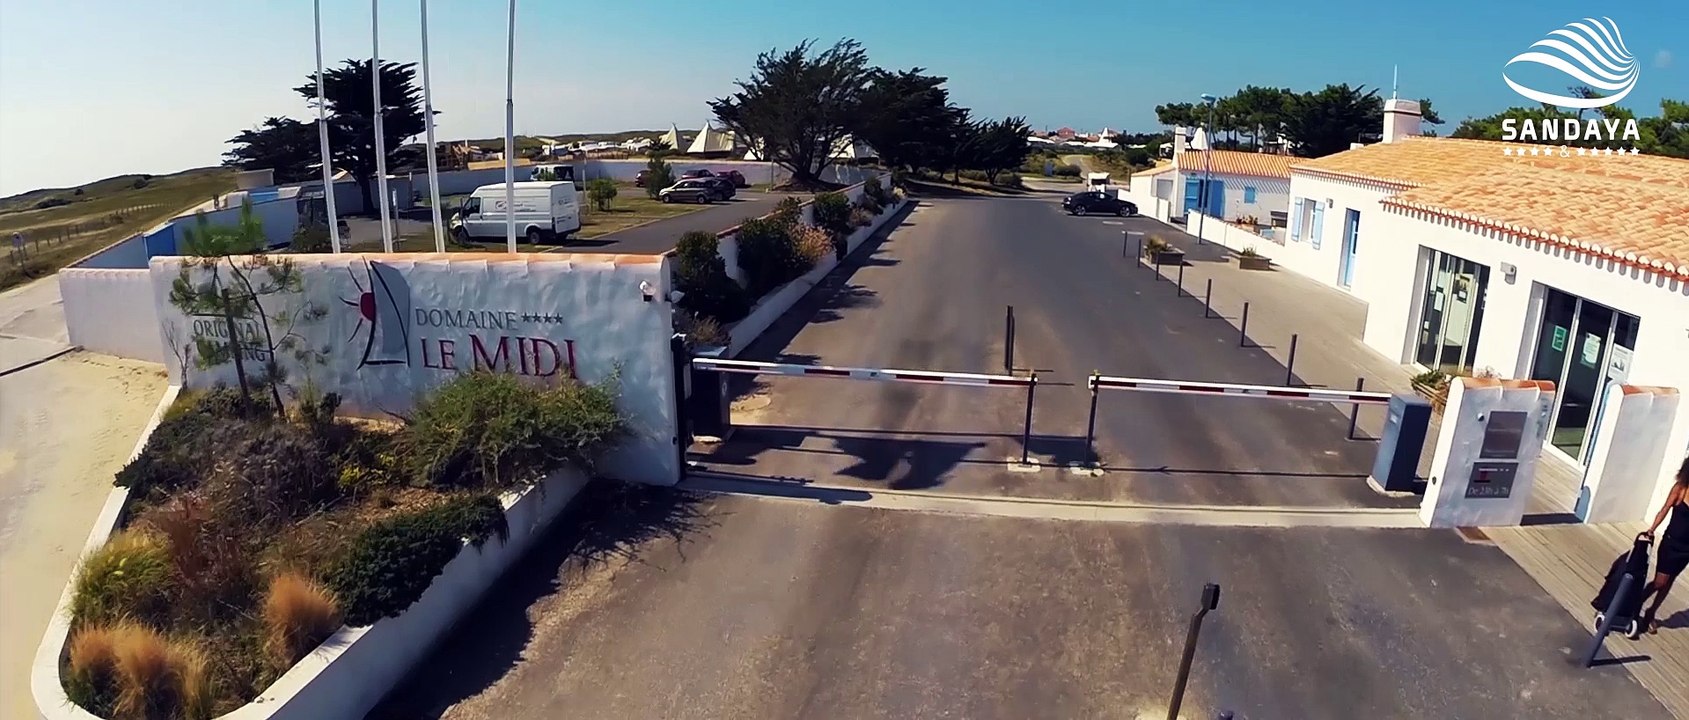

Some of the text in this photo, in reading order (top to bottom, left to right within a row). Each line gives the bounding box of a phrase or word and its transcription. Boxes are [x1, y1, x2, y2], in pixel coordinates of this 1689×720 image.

[193, 319, 262, 341] ORIGNAL
[415, 307, 518, 331] DOMAINE
[420, 333, 579, 380] LE MIDI
